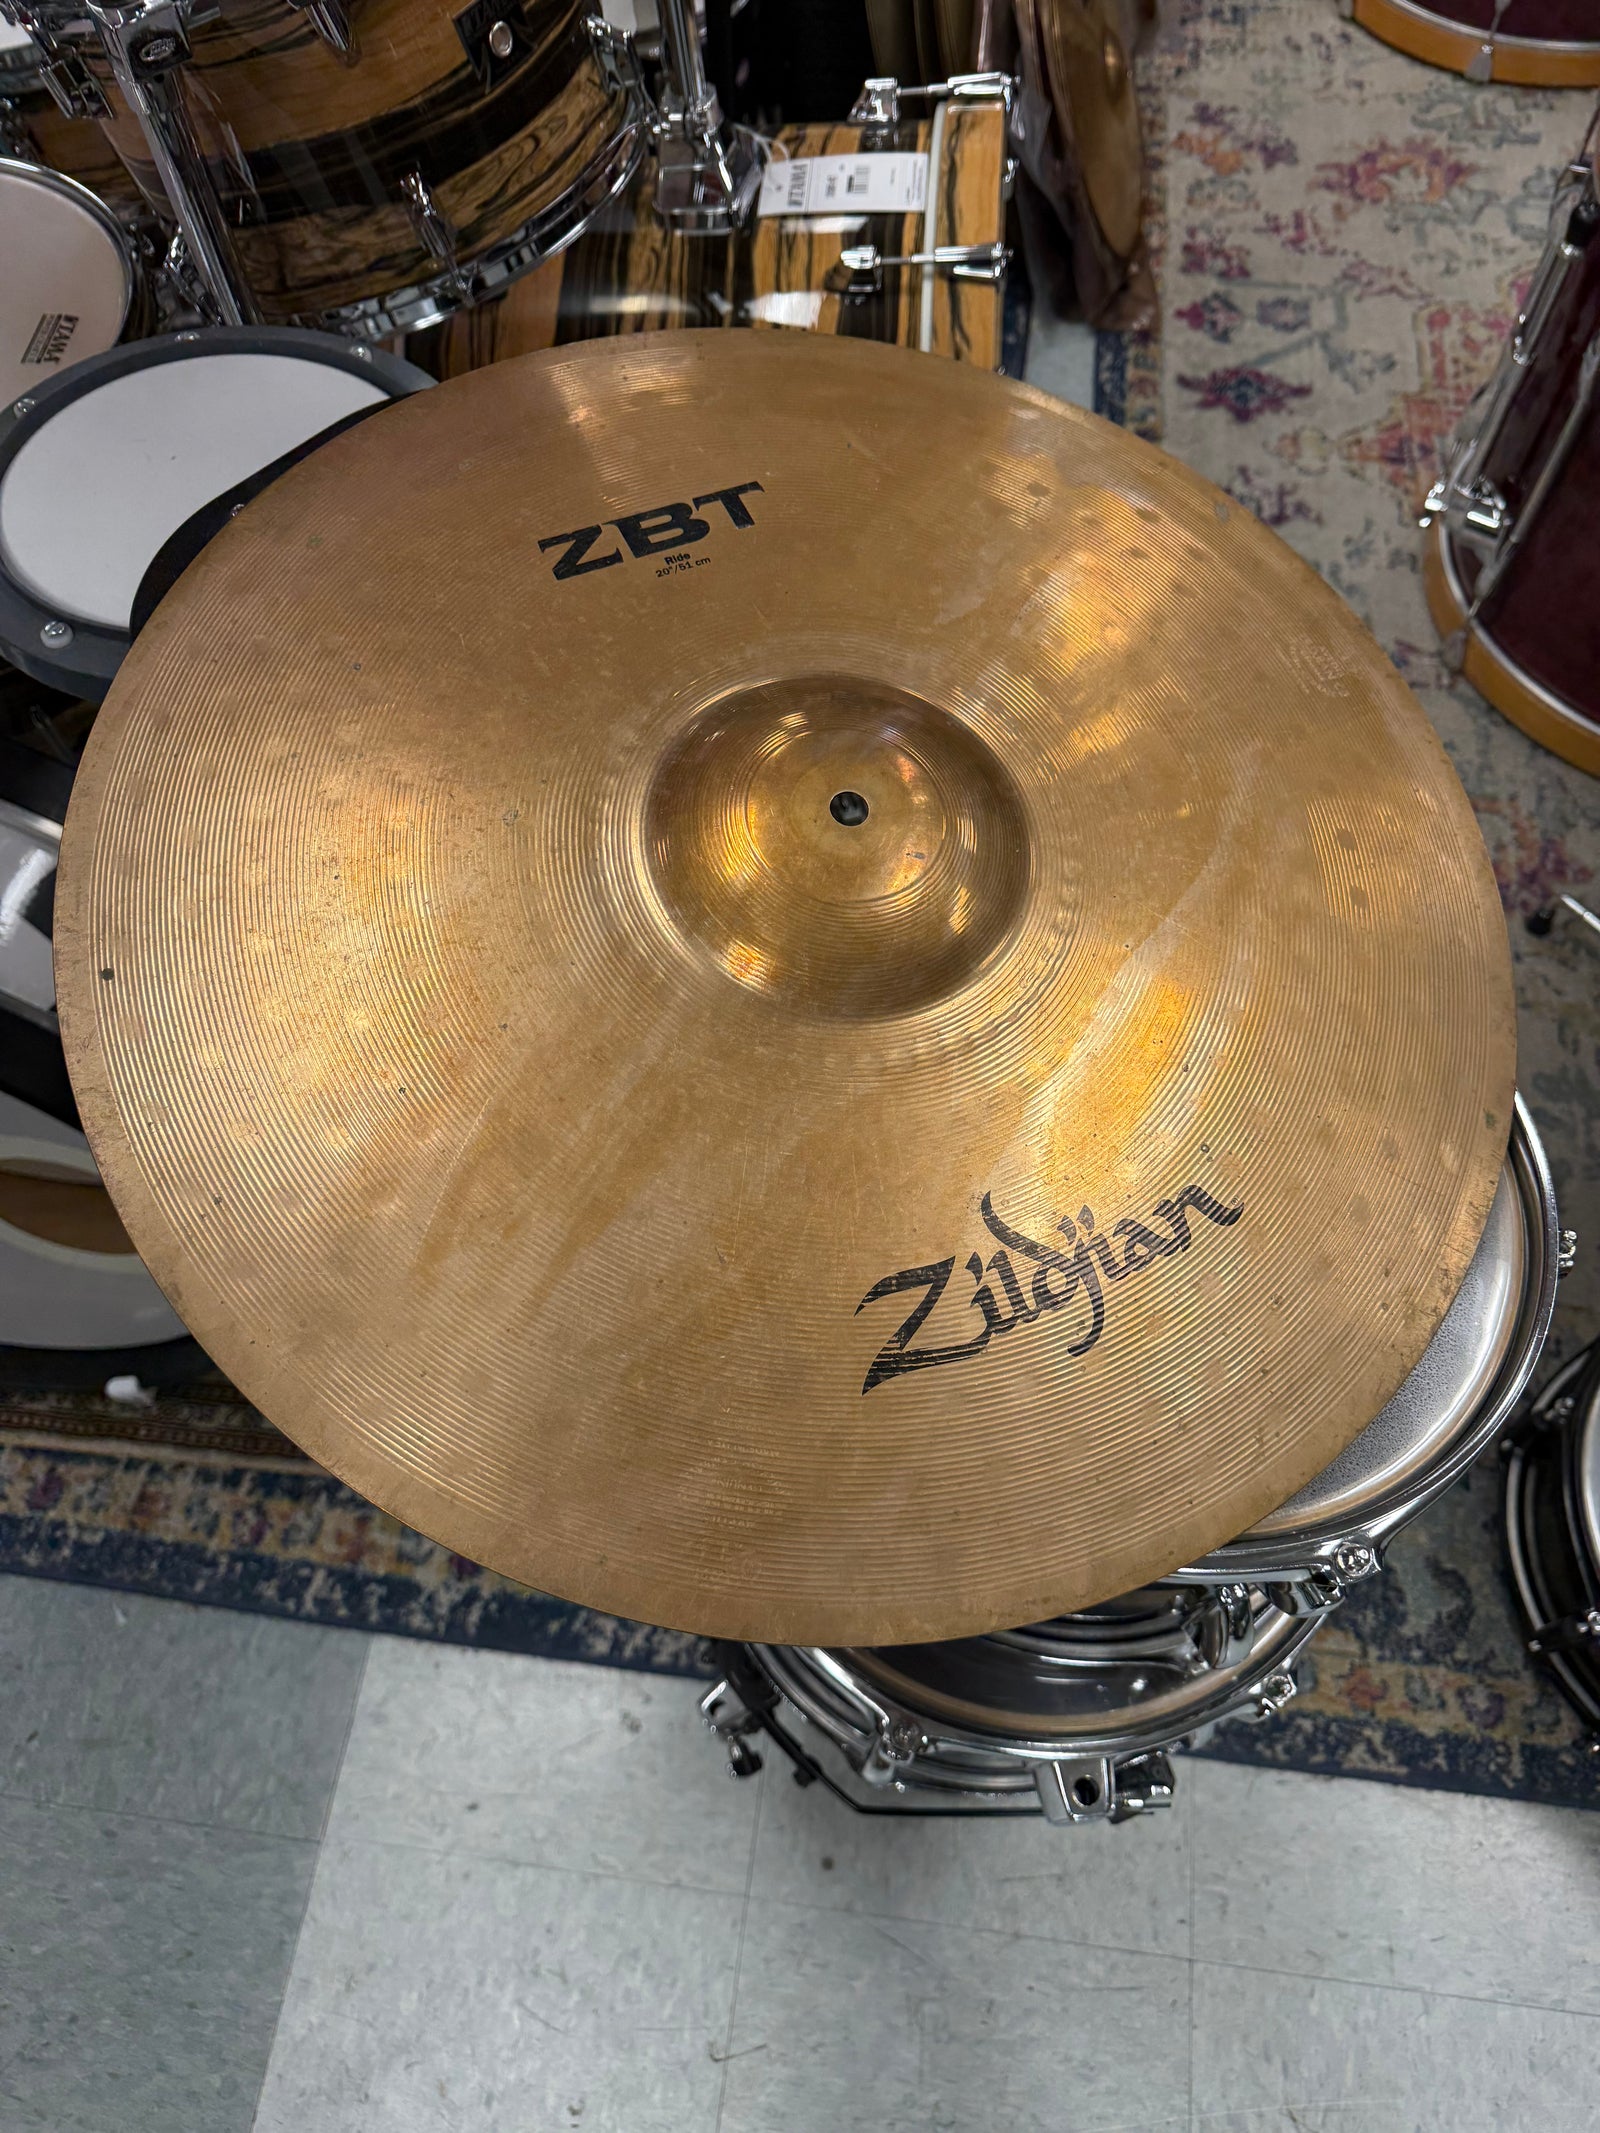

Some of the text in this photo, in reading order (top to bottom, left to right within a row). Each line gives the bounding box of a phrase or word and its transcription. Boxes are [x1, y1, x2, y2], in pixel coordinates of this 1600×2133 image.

[43, 316, 79, 365] TAMA
[538, 481, 765, 581] ZBT
[655, 557, 711, 578] 20"/51 cm
[664, 553, 691, 565] Ride
[855, 1184, 1244, 1396] Zildjian
